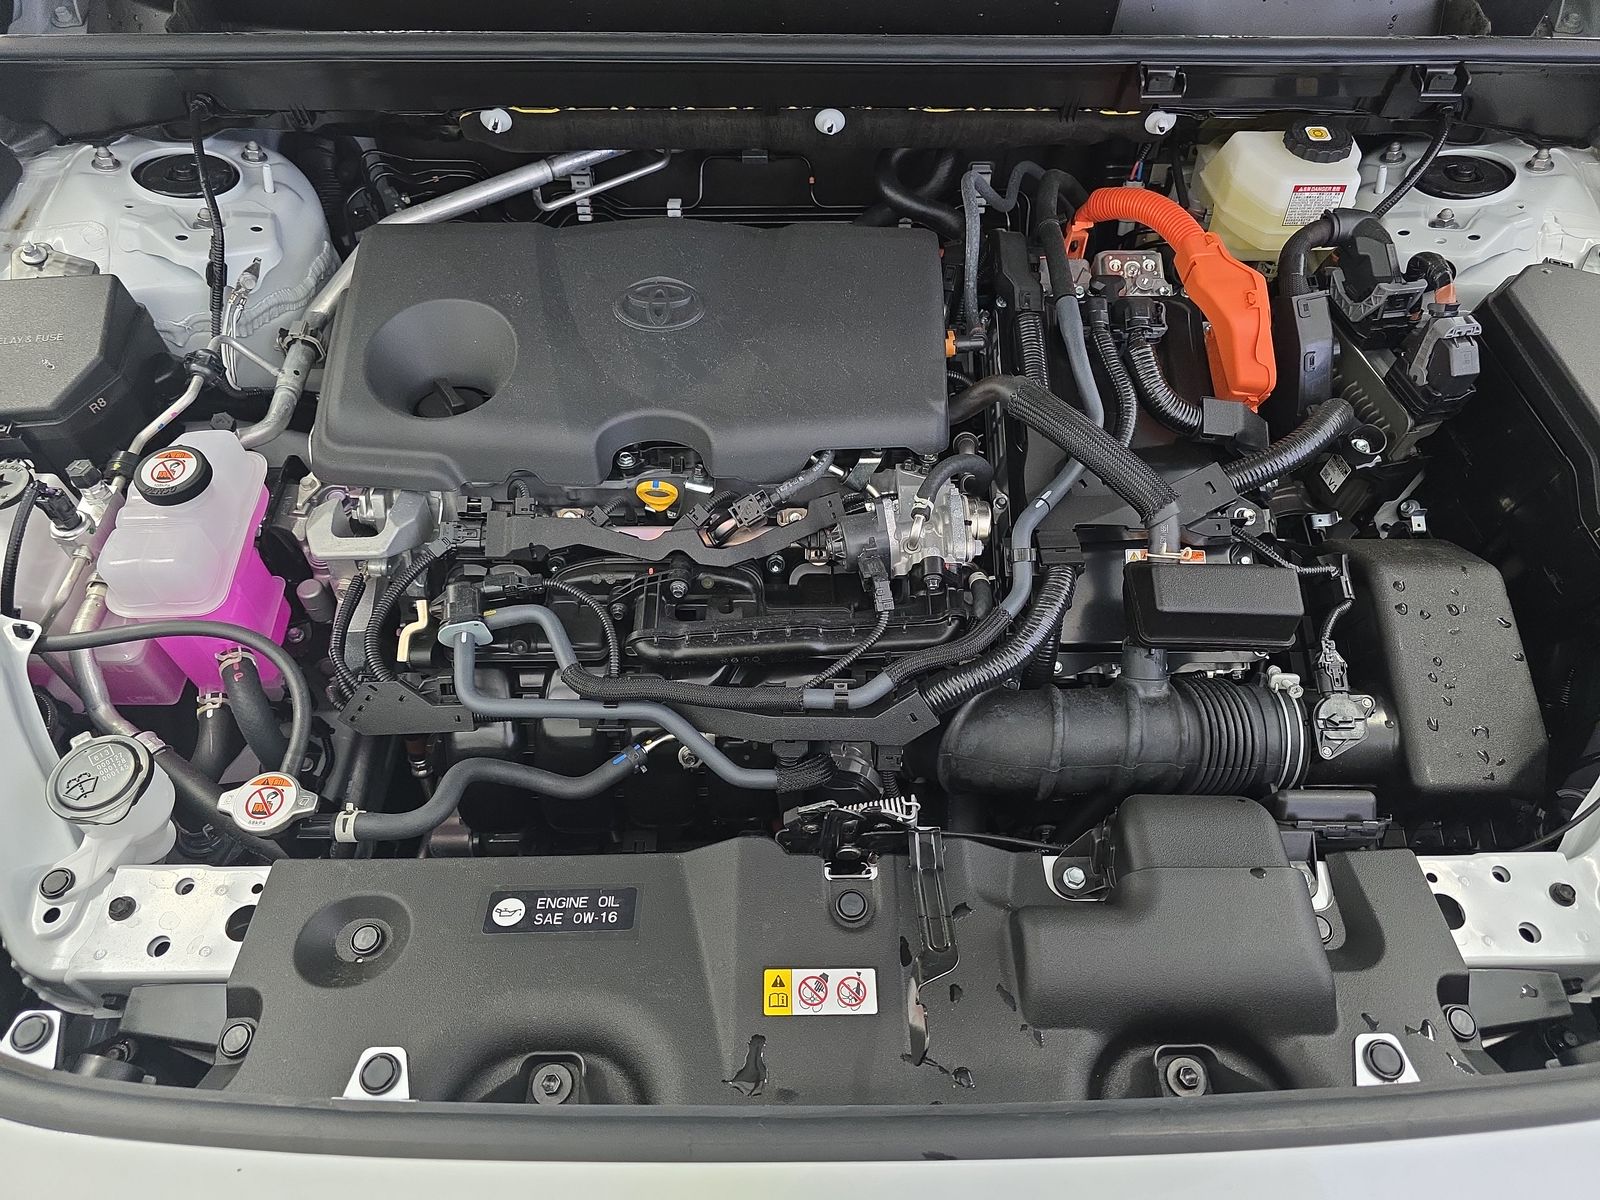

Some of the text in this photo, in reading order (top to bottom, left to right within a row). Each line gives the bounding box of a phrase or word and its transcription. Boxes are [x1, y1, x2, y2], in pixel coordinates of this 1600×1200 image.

[35, 333, 64, 342] FUSE
[88, 397, 107, 414] R8
[96, 752, 123, 770] 000127
[99, 758, 127, 776] 000128
[536, 895, 620, 909] ENGINE OIL
[533, 911, 618, 925] SAE 0W-16
